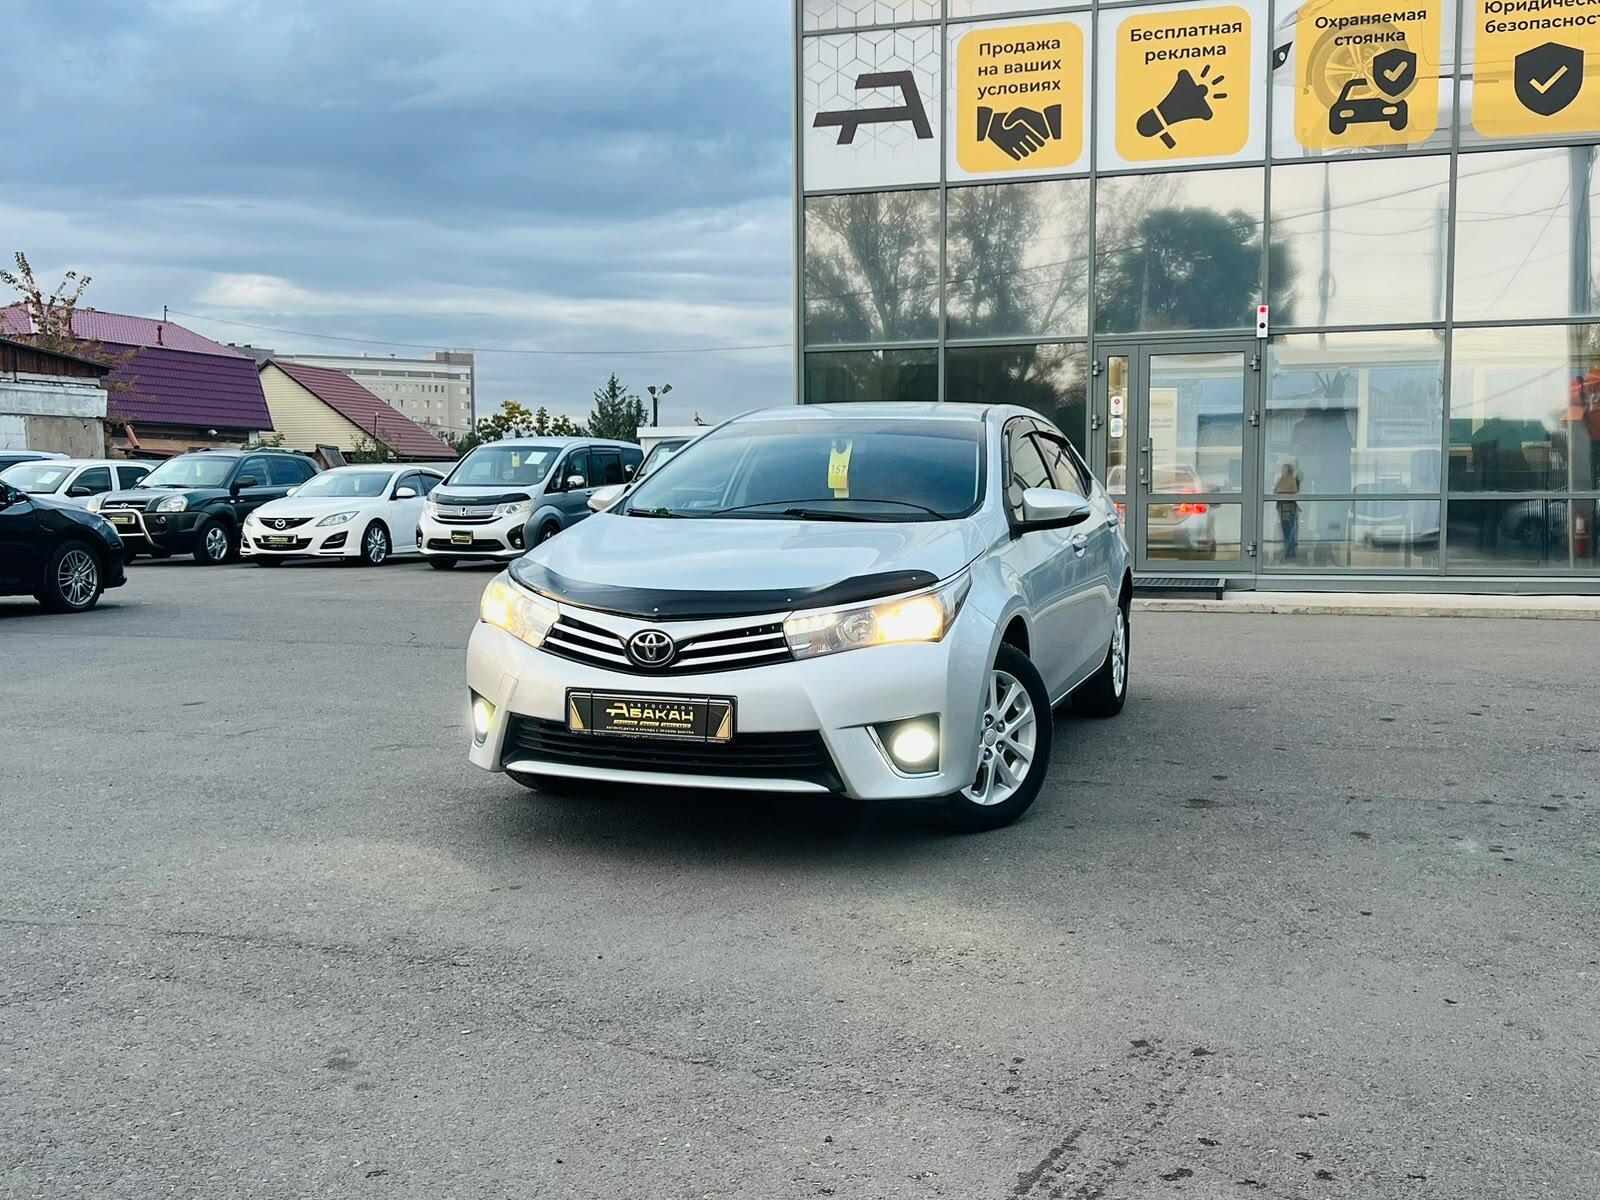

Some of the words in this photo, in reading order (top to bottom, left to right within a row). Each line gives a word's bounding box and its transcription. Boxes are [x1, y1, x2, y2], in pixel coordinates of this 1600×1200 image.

[1485, 0, 1600, 15] Юридичес
[1315, 10, 1427, 30] Охраняемая
[1130, 22, 1242, 42] Бесплатная
[1334, 31, 1406, 46] стоянка
[979, 38, 1061, 58] Продажа
[1145, 44, 1227, 65] реклама
[978, 65, 998, 77] на
[1004, 59, 1061, 74] ваших
[977, 80, 1061, 100] условиях
[831, 464, 847, 474] 157
[605, 702, 694, 721] АБАКАН
[630, 702, 693, 711] АВТОСАЛОН
